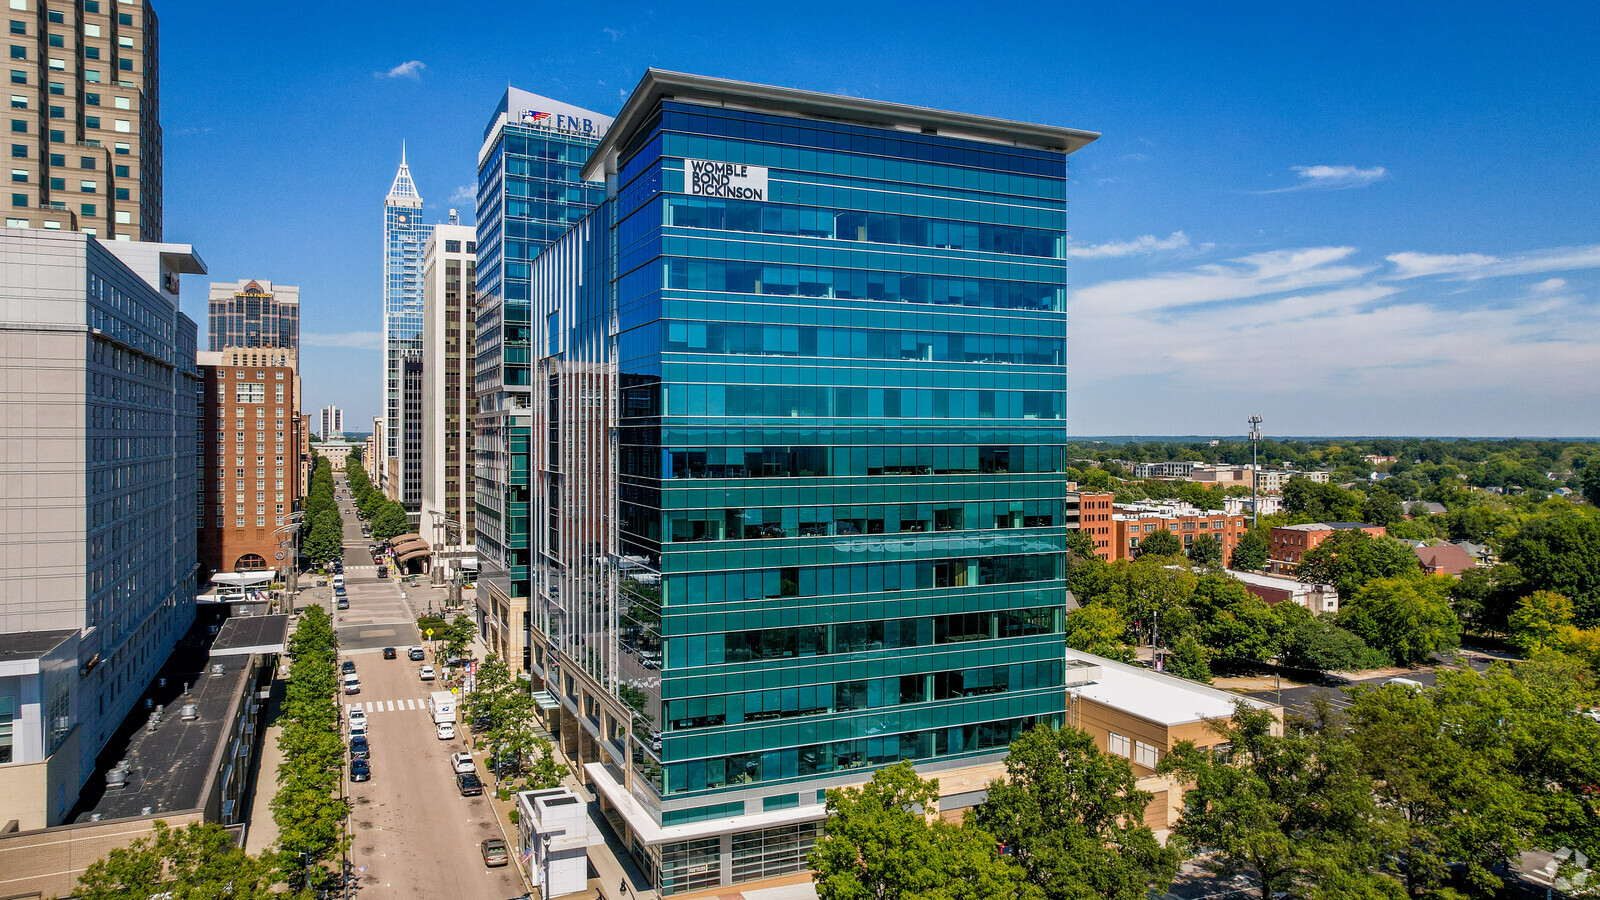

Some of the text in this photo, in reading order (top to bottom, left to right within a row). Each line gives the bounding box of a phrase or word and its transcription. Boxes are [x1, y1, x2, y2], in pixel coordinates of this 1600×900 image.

[691, 161, 748, 178] WOMBLE
[692, 171, 730, 186] BOND
[692, 183, 763, 200] DICKINSON
